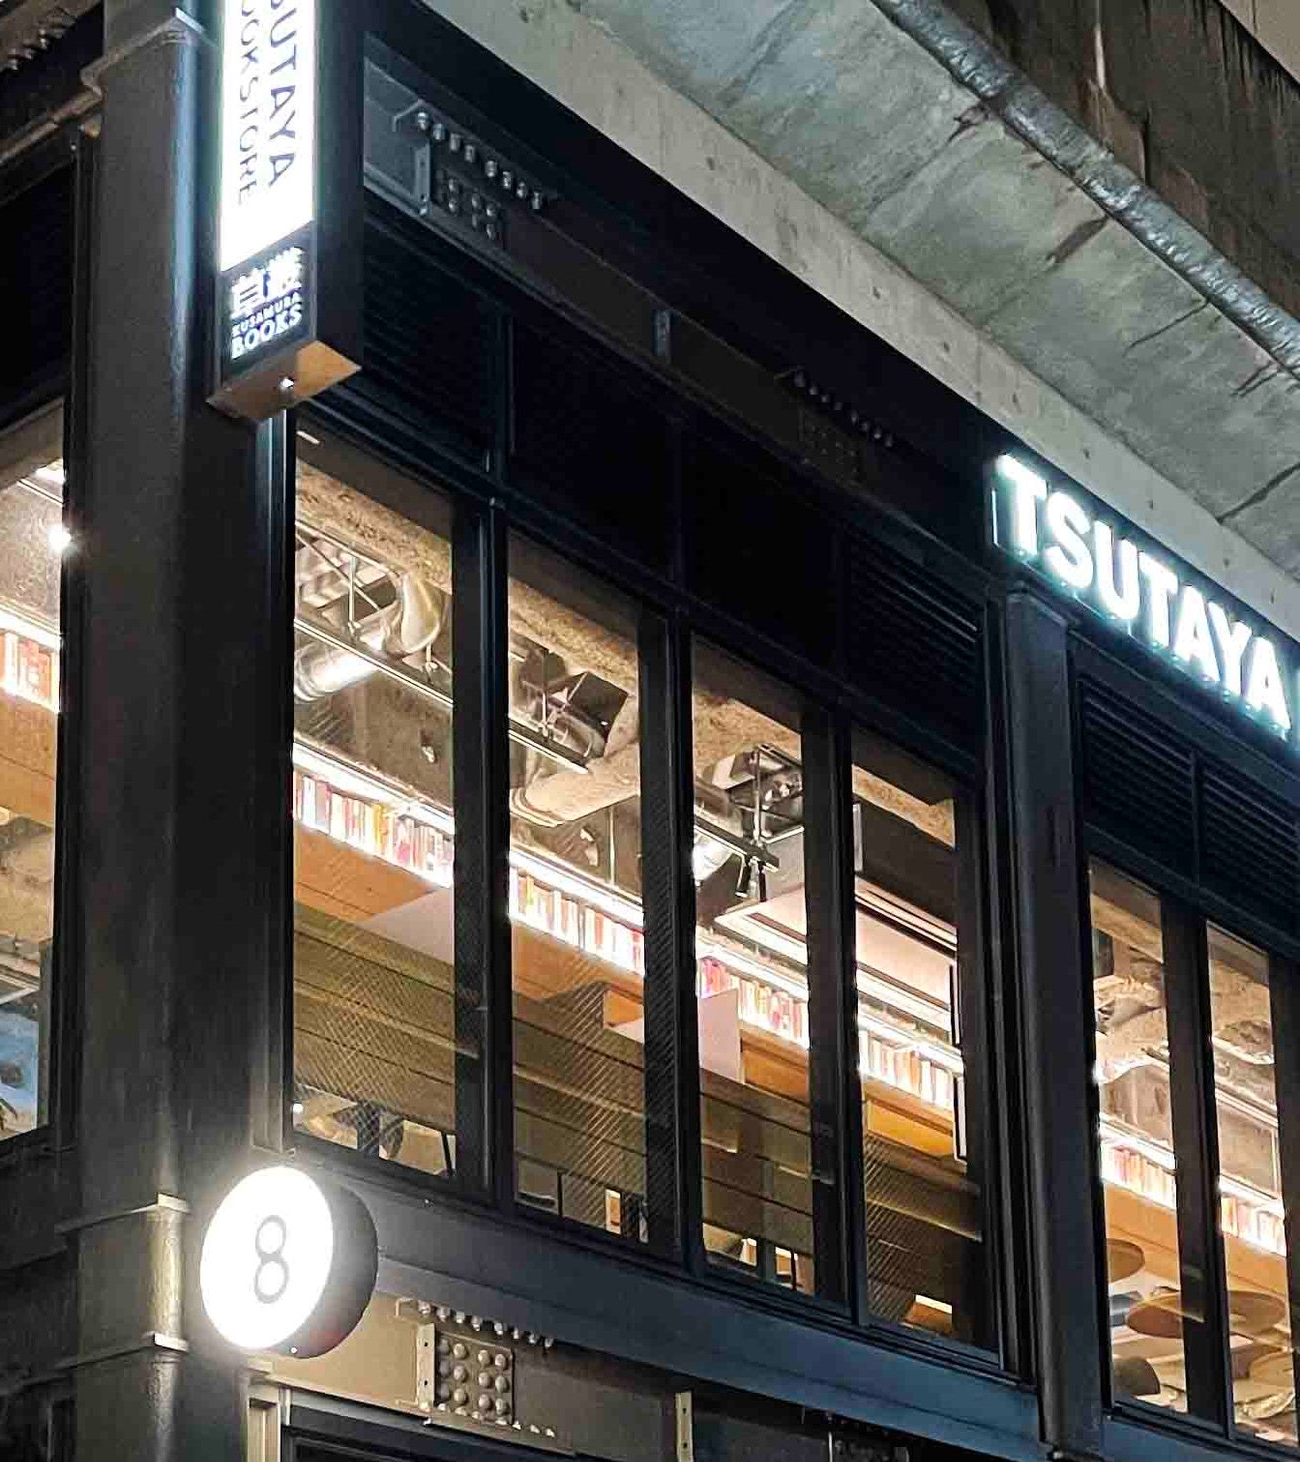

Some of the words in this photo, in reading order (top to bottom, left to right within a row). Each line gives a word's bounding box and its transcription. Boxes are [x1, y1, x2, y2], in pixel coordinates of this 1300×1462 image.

[231, 304, 303, 360] BOOKS
[994, 453, 1291, 738] TSUTAYA
[253, 1214, 290, 1305] 8
